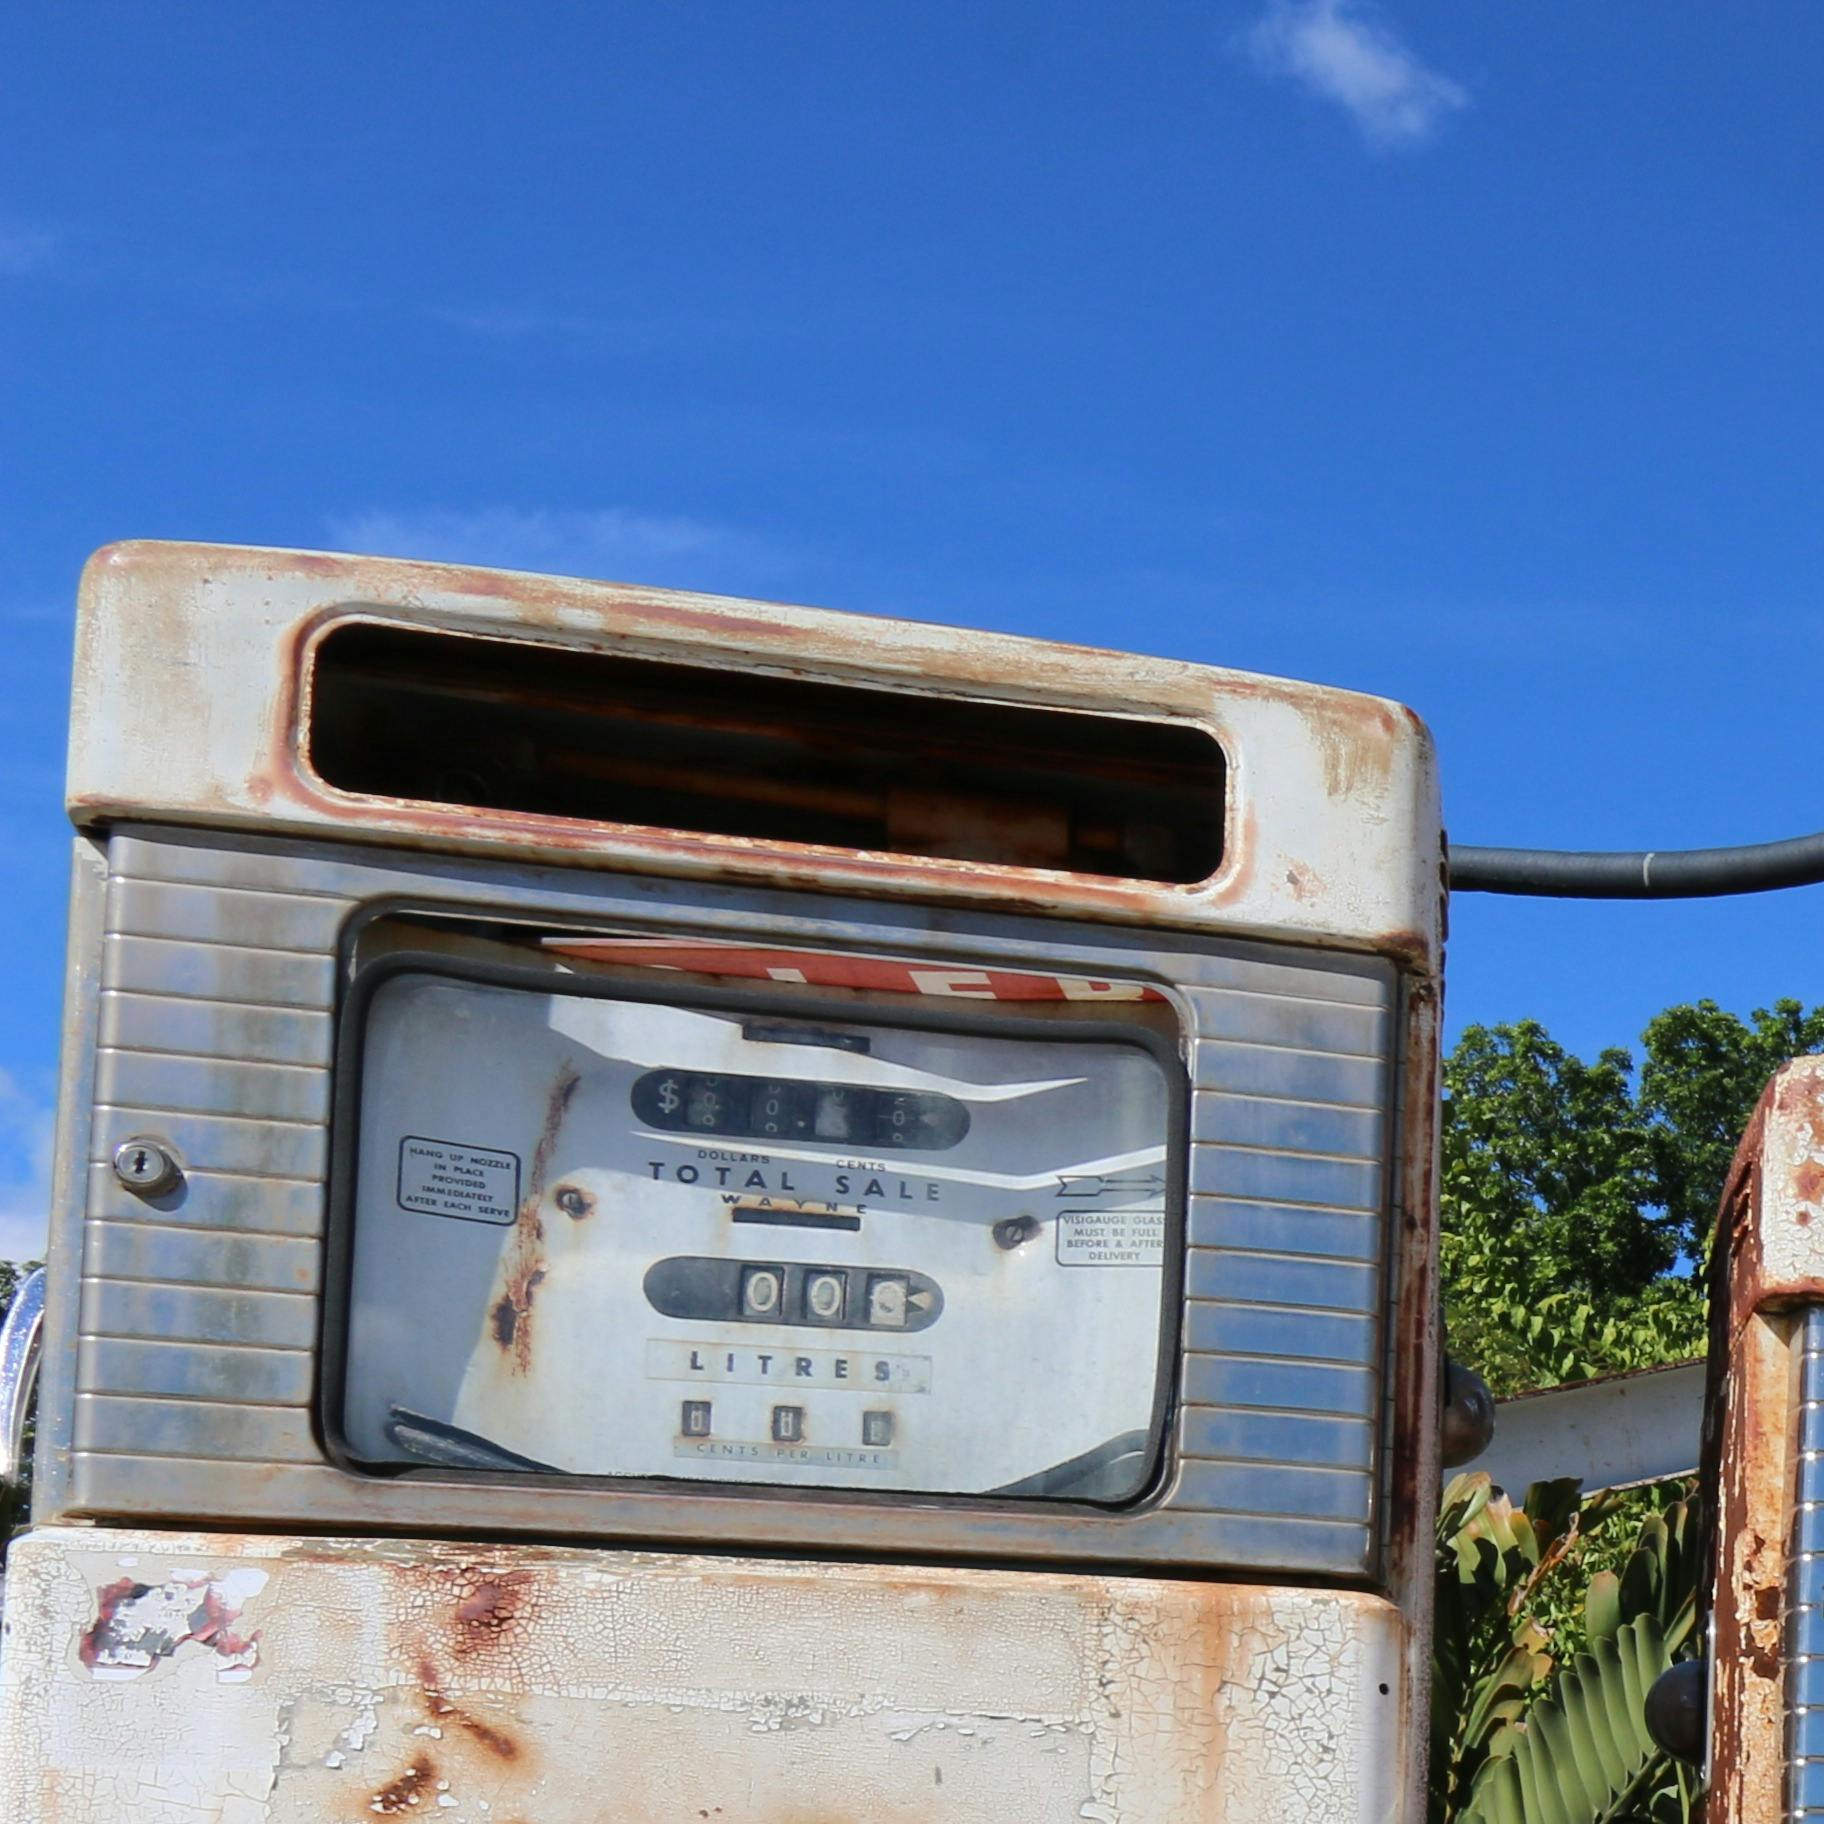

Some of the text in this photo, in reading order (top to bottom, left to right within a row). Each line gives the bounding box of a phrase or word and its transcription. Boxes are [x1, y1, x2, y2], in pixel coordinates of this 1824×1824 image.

[409, 1147, 511, 1170] HANG UP NOZZLE
[697, 1150, 887, 1172] DOLLARS CENTS
[433, 1163, 485, 1178] IN PLACE
[431, 1174, 487, 1189] PROVIDED
[648, 1161, 941, 1201] TOTAL SALE
[421, 1185, 494, 1203] IMMEDIATELY
[406, 1195, 510, 1218] AFTER EACH SERVE
[720, 1193, 868, 1215] WAYNE
[1062, 1215, 1128, 1225] VISIGAUGE
[1073, 1228, 1159, 1237] MUST BE FULL
[1066, 1239, 1165, 1249] BEFORE & AFTER
[1088, 1251, 1141, 1261] DELIVERY
[690, 1350, 891, 1382] LITRES
[696, 1443, 881, 1464] CENTS PER LITRE
